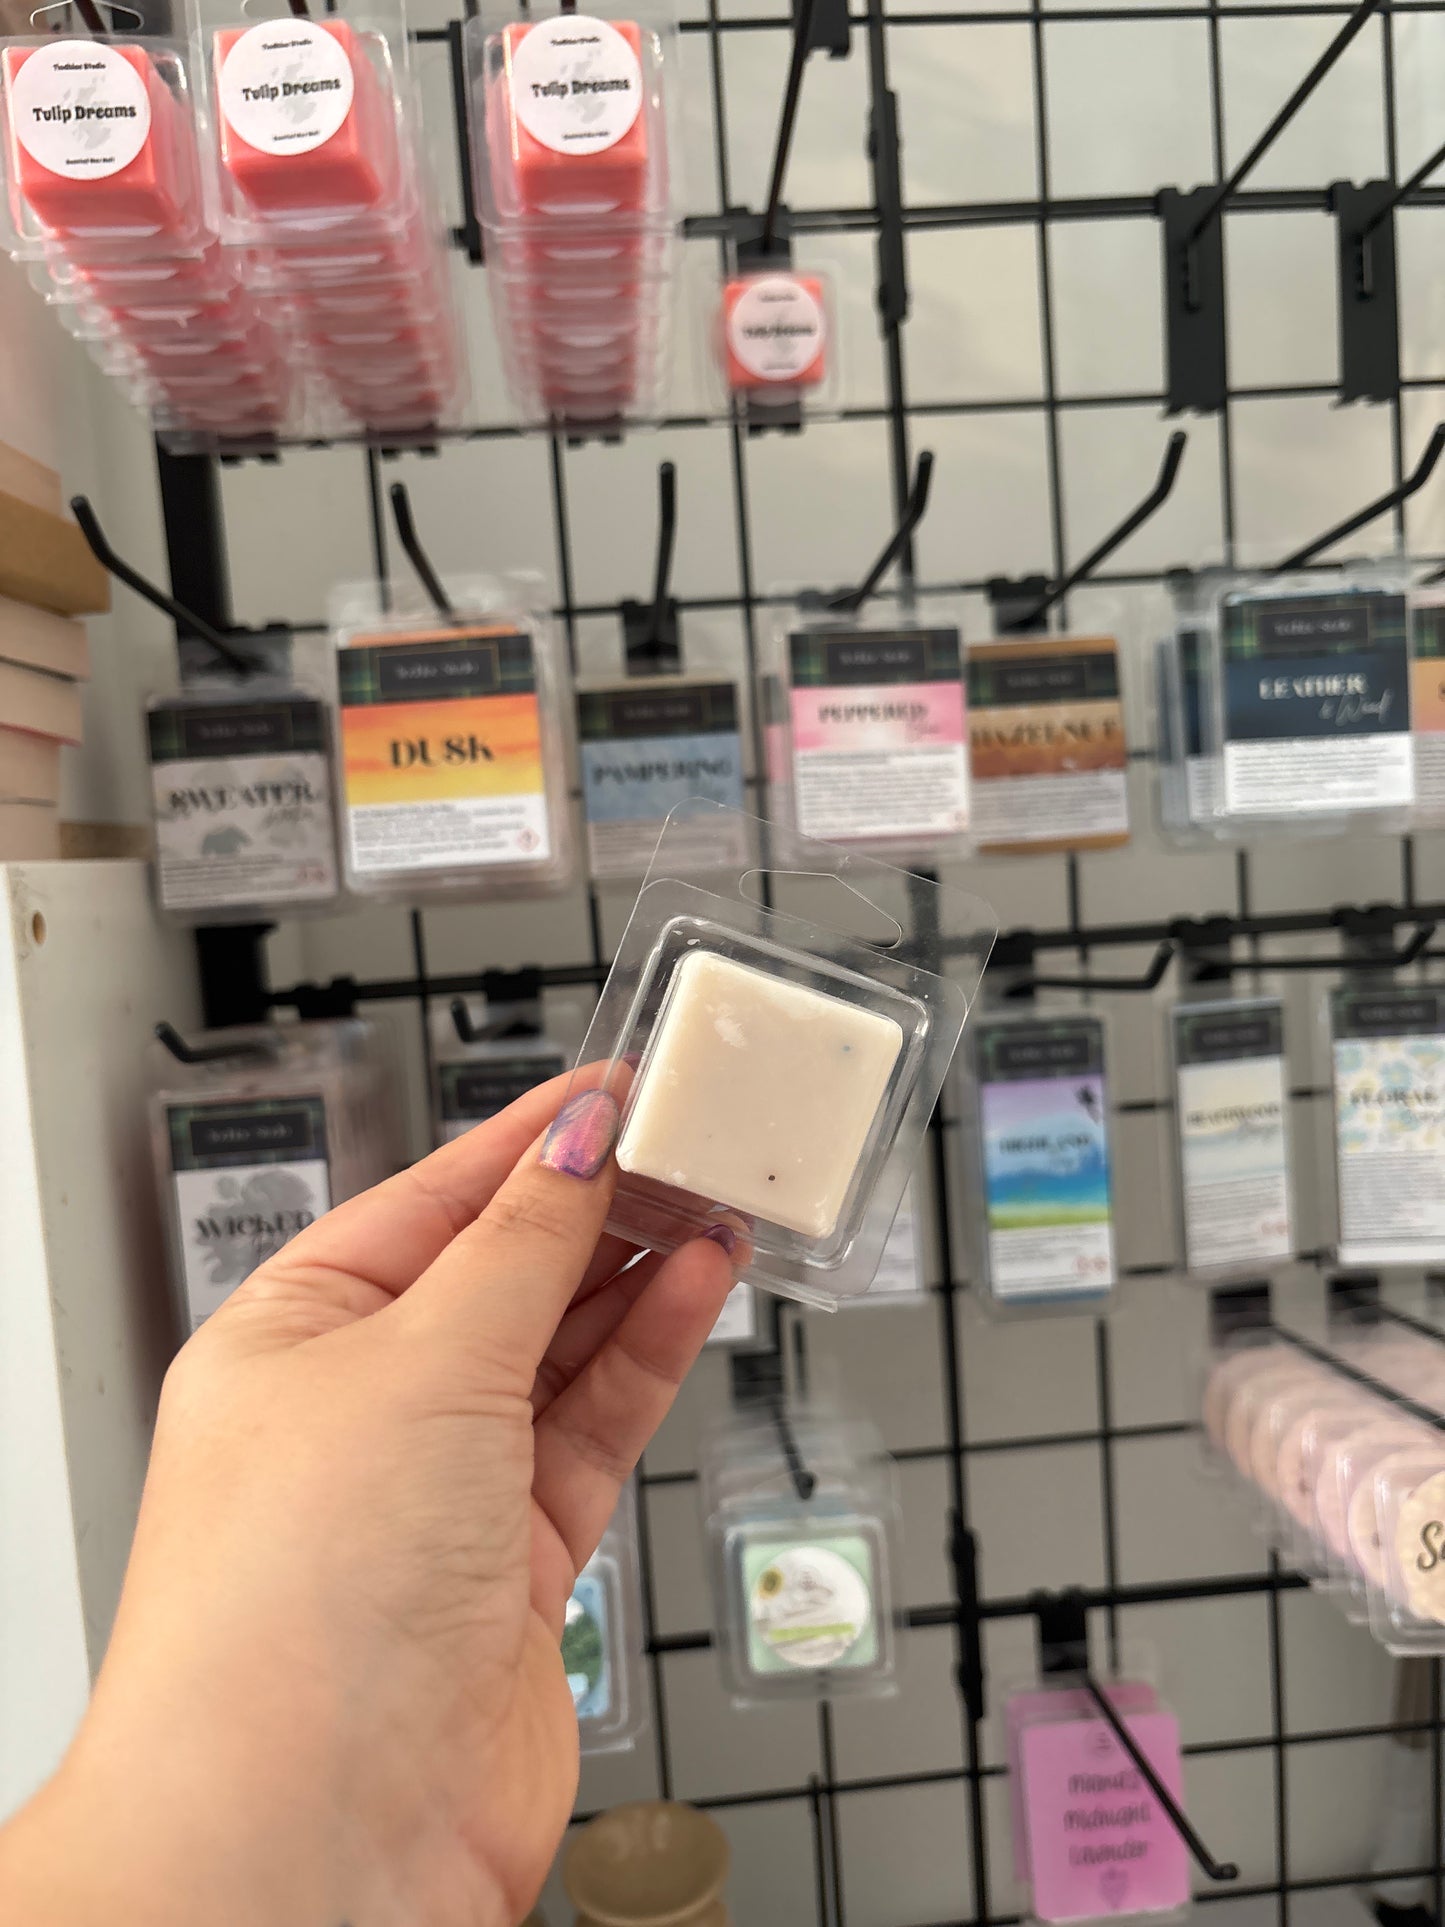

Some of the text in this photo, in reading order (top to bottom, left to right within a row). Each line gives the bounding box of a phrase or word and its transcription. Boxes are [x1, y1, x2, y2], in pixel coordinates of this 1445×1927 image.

[242, 79, 341, 101] Tulip Dreams
[532, 79, 630, 99] Tulip Dreams
[32, 104, 137, 123] Tulip Dreams
[1258, 673, 1368, 700] LEATHER
[389, 734, 496, 768] DUSK
[169, 778, 314, 814] SWEATER
[195, 1209, 315, 1238] WICKED
[1417, 1520, 1445, 1573] S
